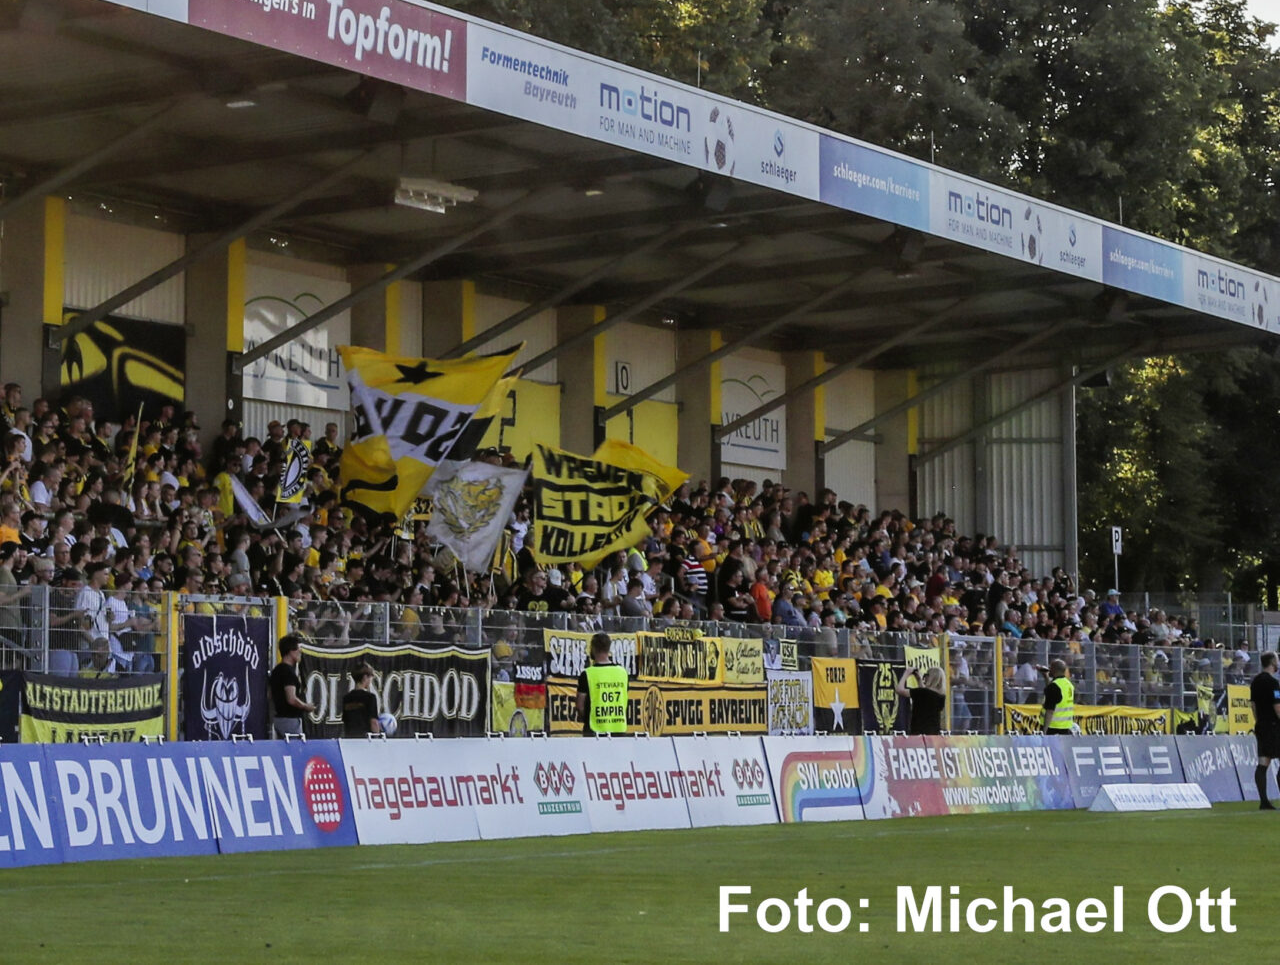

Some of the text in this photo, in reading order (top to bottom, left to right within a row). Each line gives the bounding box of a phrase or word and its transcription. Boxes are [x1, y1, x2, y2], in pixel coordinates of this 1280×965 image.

[481, 45, 570, 87] Formentechnik
[523, 80, 577, 110] Bayreuth
[599, 82, 691, 133] motion
[599, 115, 692, 156] FOR MAN AND MACHINE
[760, 160, 797, 184] schlaeger
[833, 162, 920, 202] schlaeger.com/karriere
[948, 190, 1013, 230] motion
[948, 218, 960, 233] FOR
[1197, 268, 1246, 301] motion
[1114, 529, 1121, 551] P
[879, 663, 892, 687] 25
[25, 681, 164, 714] ALTSTADTFREUNDE
[601, 691, 622, 703] 067
[665, 699, 703, 726] SPVGG
[708, 698, 766, 725] BAYREUTH
[888, 746, 1060, 780] FARBE IST UNSER LEBEN.
[1215, 746, 1233, 771] AM
[537, 767, 575, 790] BHG
[582, 760, 725, 810] hagebaumarkt
[733, 764, 764, 786] BHG
[797, 762, 857, 790] SW color
[350, 762, 524, 821] hagebaumarkt
[736, 794, 771, 806] BAUZENTRUM
[942, 780, 1027, 806] www.swcolor.de
[538, 802, 582, 814] BAUZENTRUM
